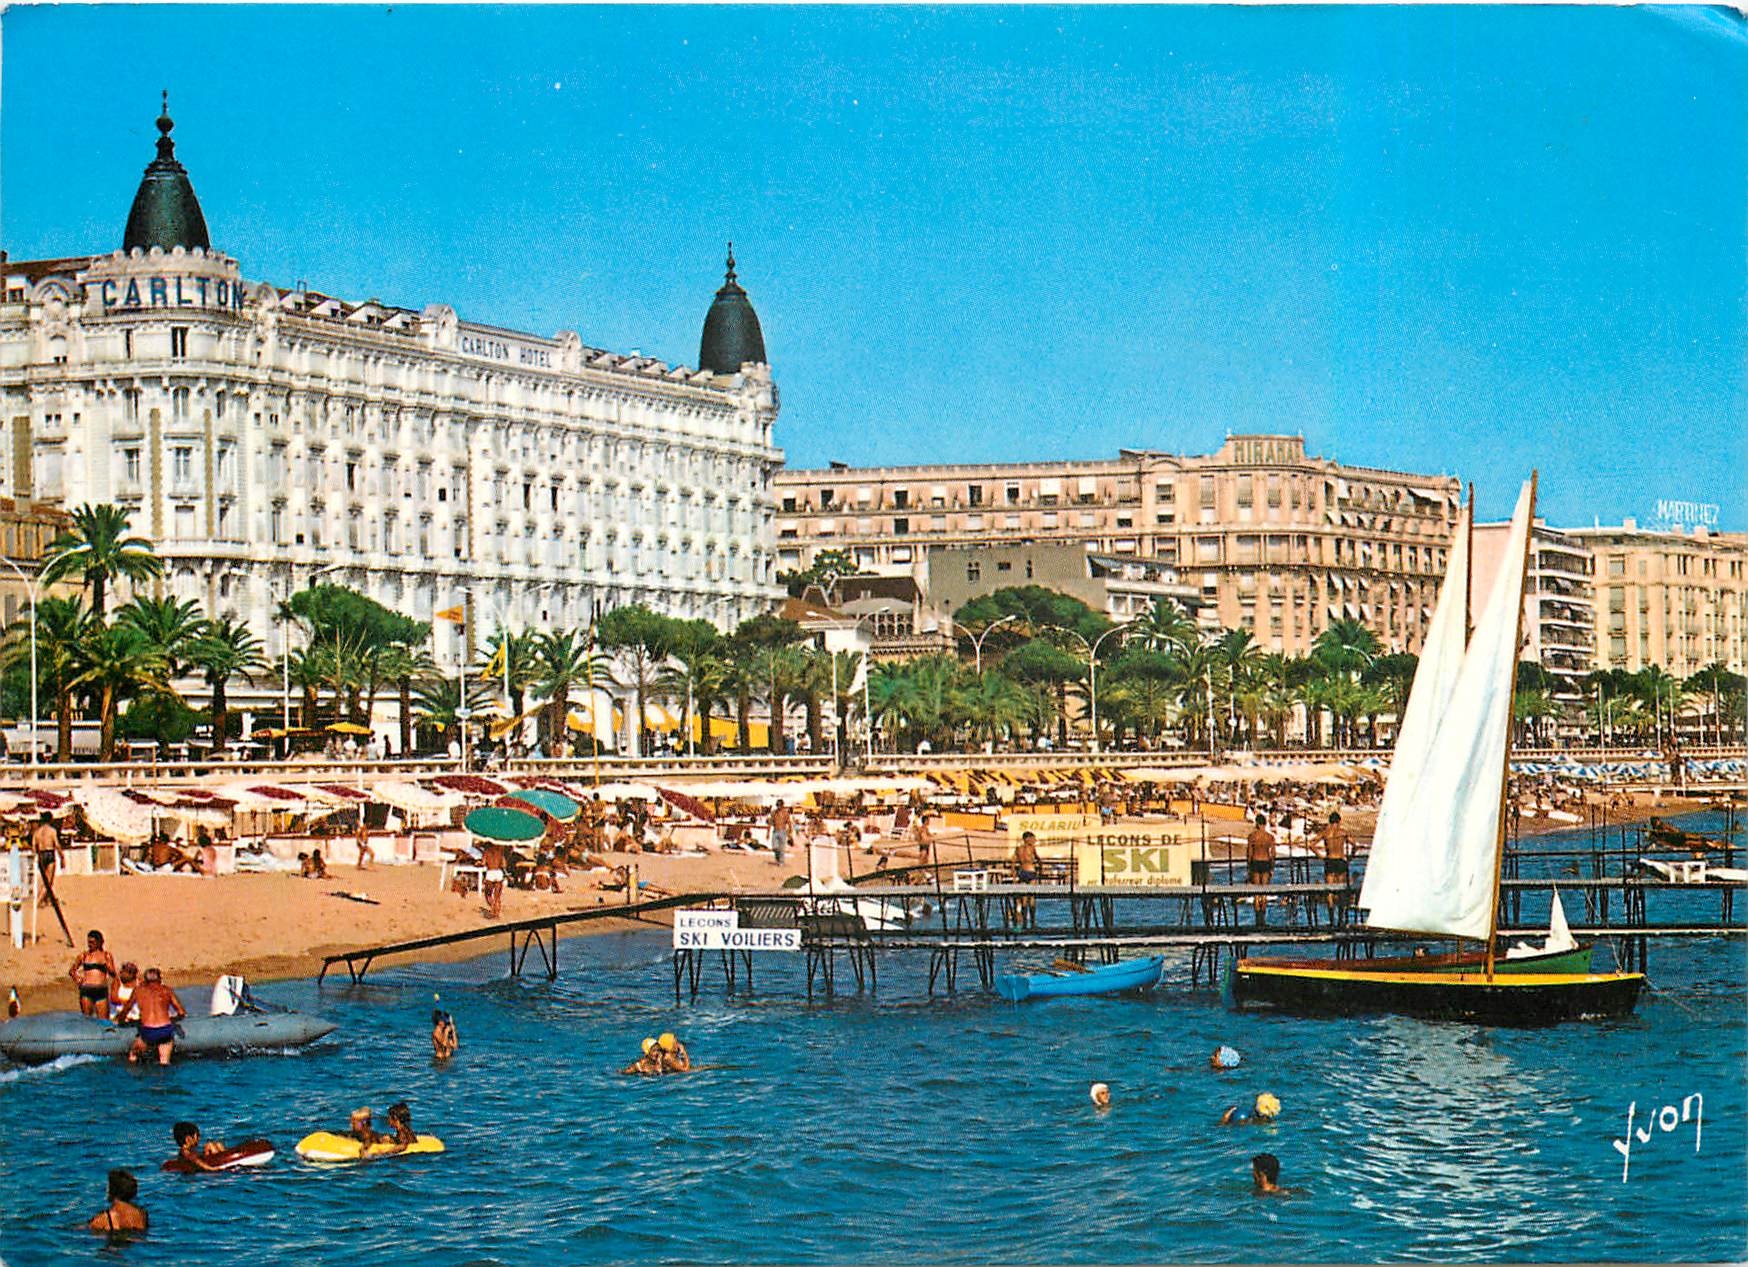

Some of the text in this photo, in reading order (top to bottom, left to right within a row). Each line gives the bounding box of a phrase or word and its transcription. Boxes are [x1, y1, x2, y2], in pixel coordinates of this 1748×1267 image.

[102, 276, 244, 311] CARLTON
[462, 336, 551, 368] CARLTON HOTEL
[1161, 834, 1182, 846] DE
[1103, 848, 1169, 872] SKI
[680, 917, 732, 928] LECONS
[680, 932, 795, 947] SKI VOILIERS
